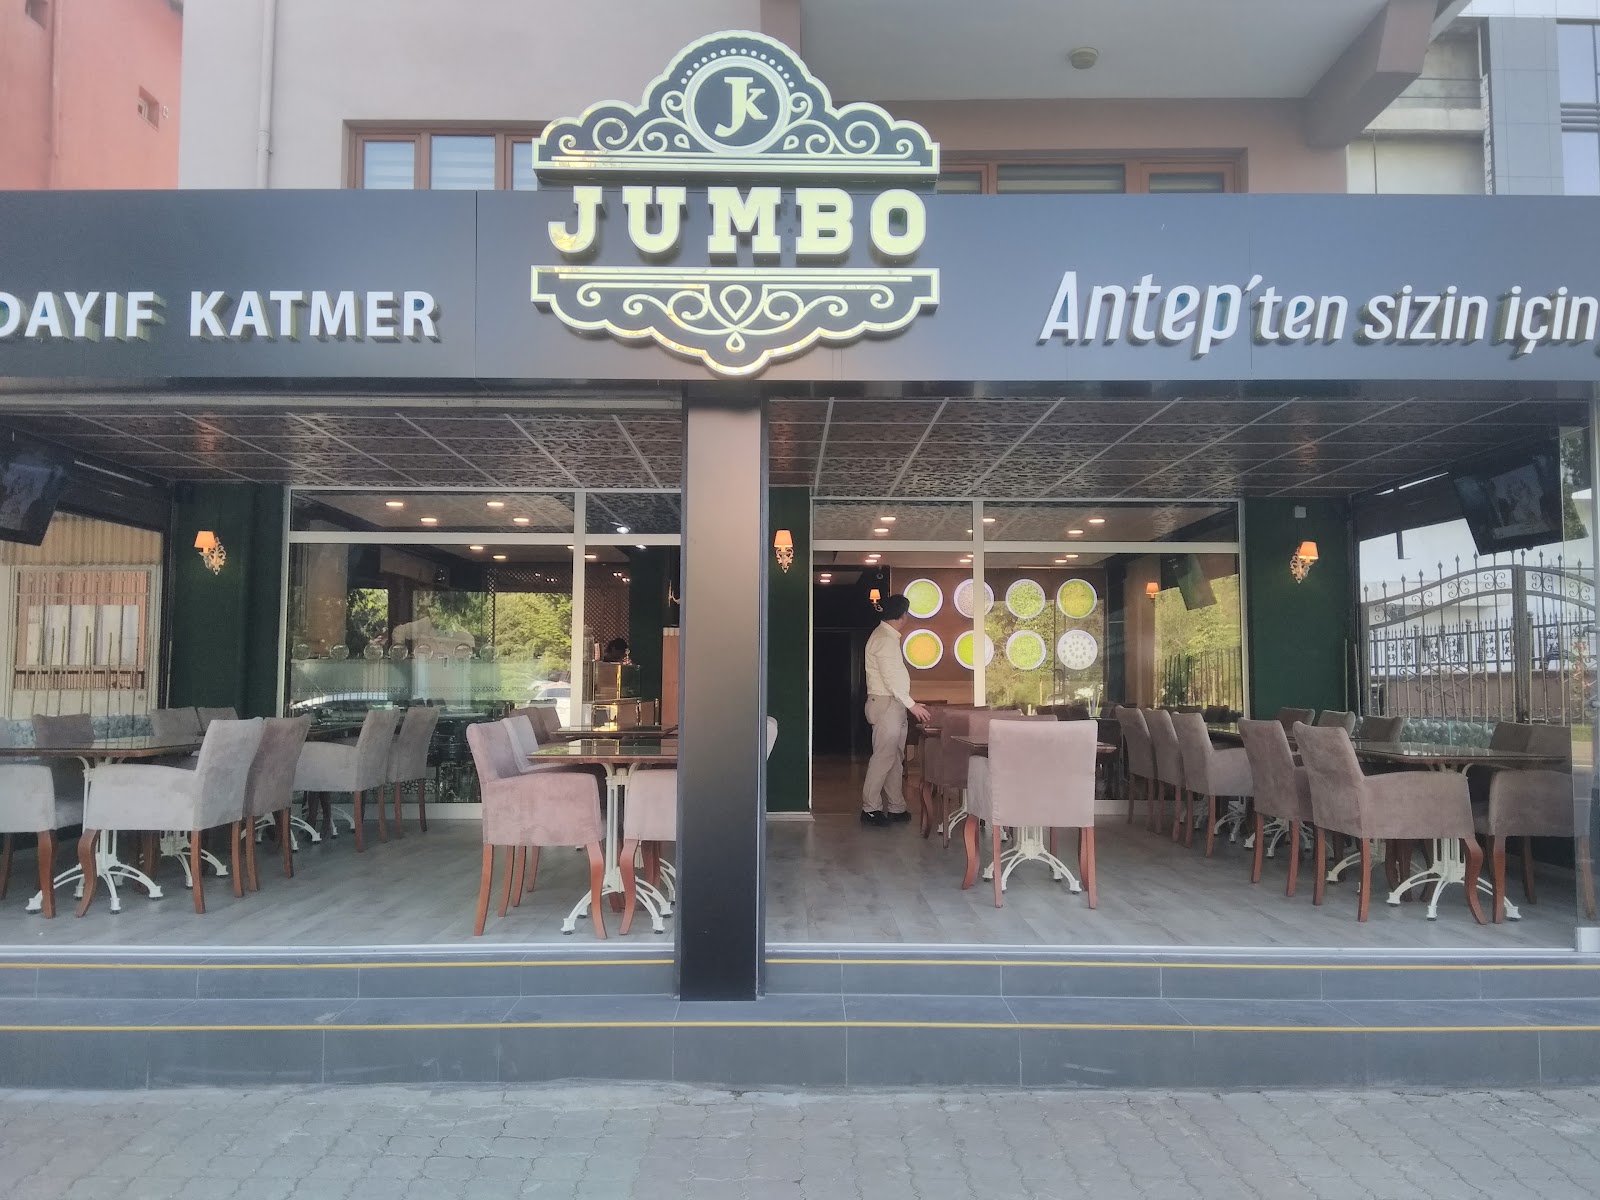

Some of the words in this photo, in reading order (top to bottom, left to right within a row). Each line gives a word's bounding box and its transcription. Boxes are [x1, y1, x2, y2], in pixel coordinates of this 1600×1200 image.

[548, 185, 927, 257] JUMBO
[189, 290, 437, 338] KATMER
[1364, 284, 1489, 341] sizin
[1504, 285, 1599, 354] için
